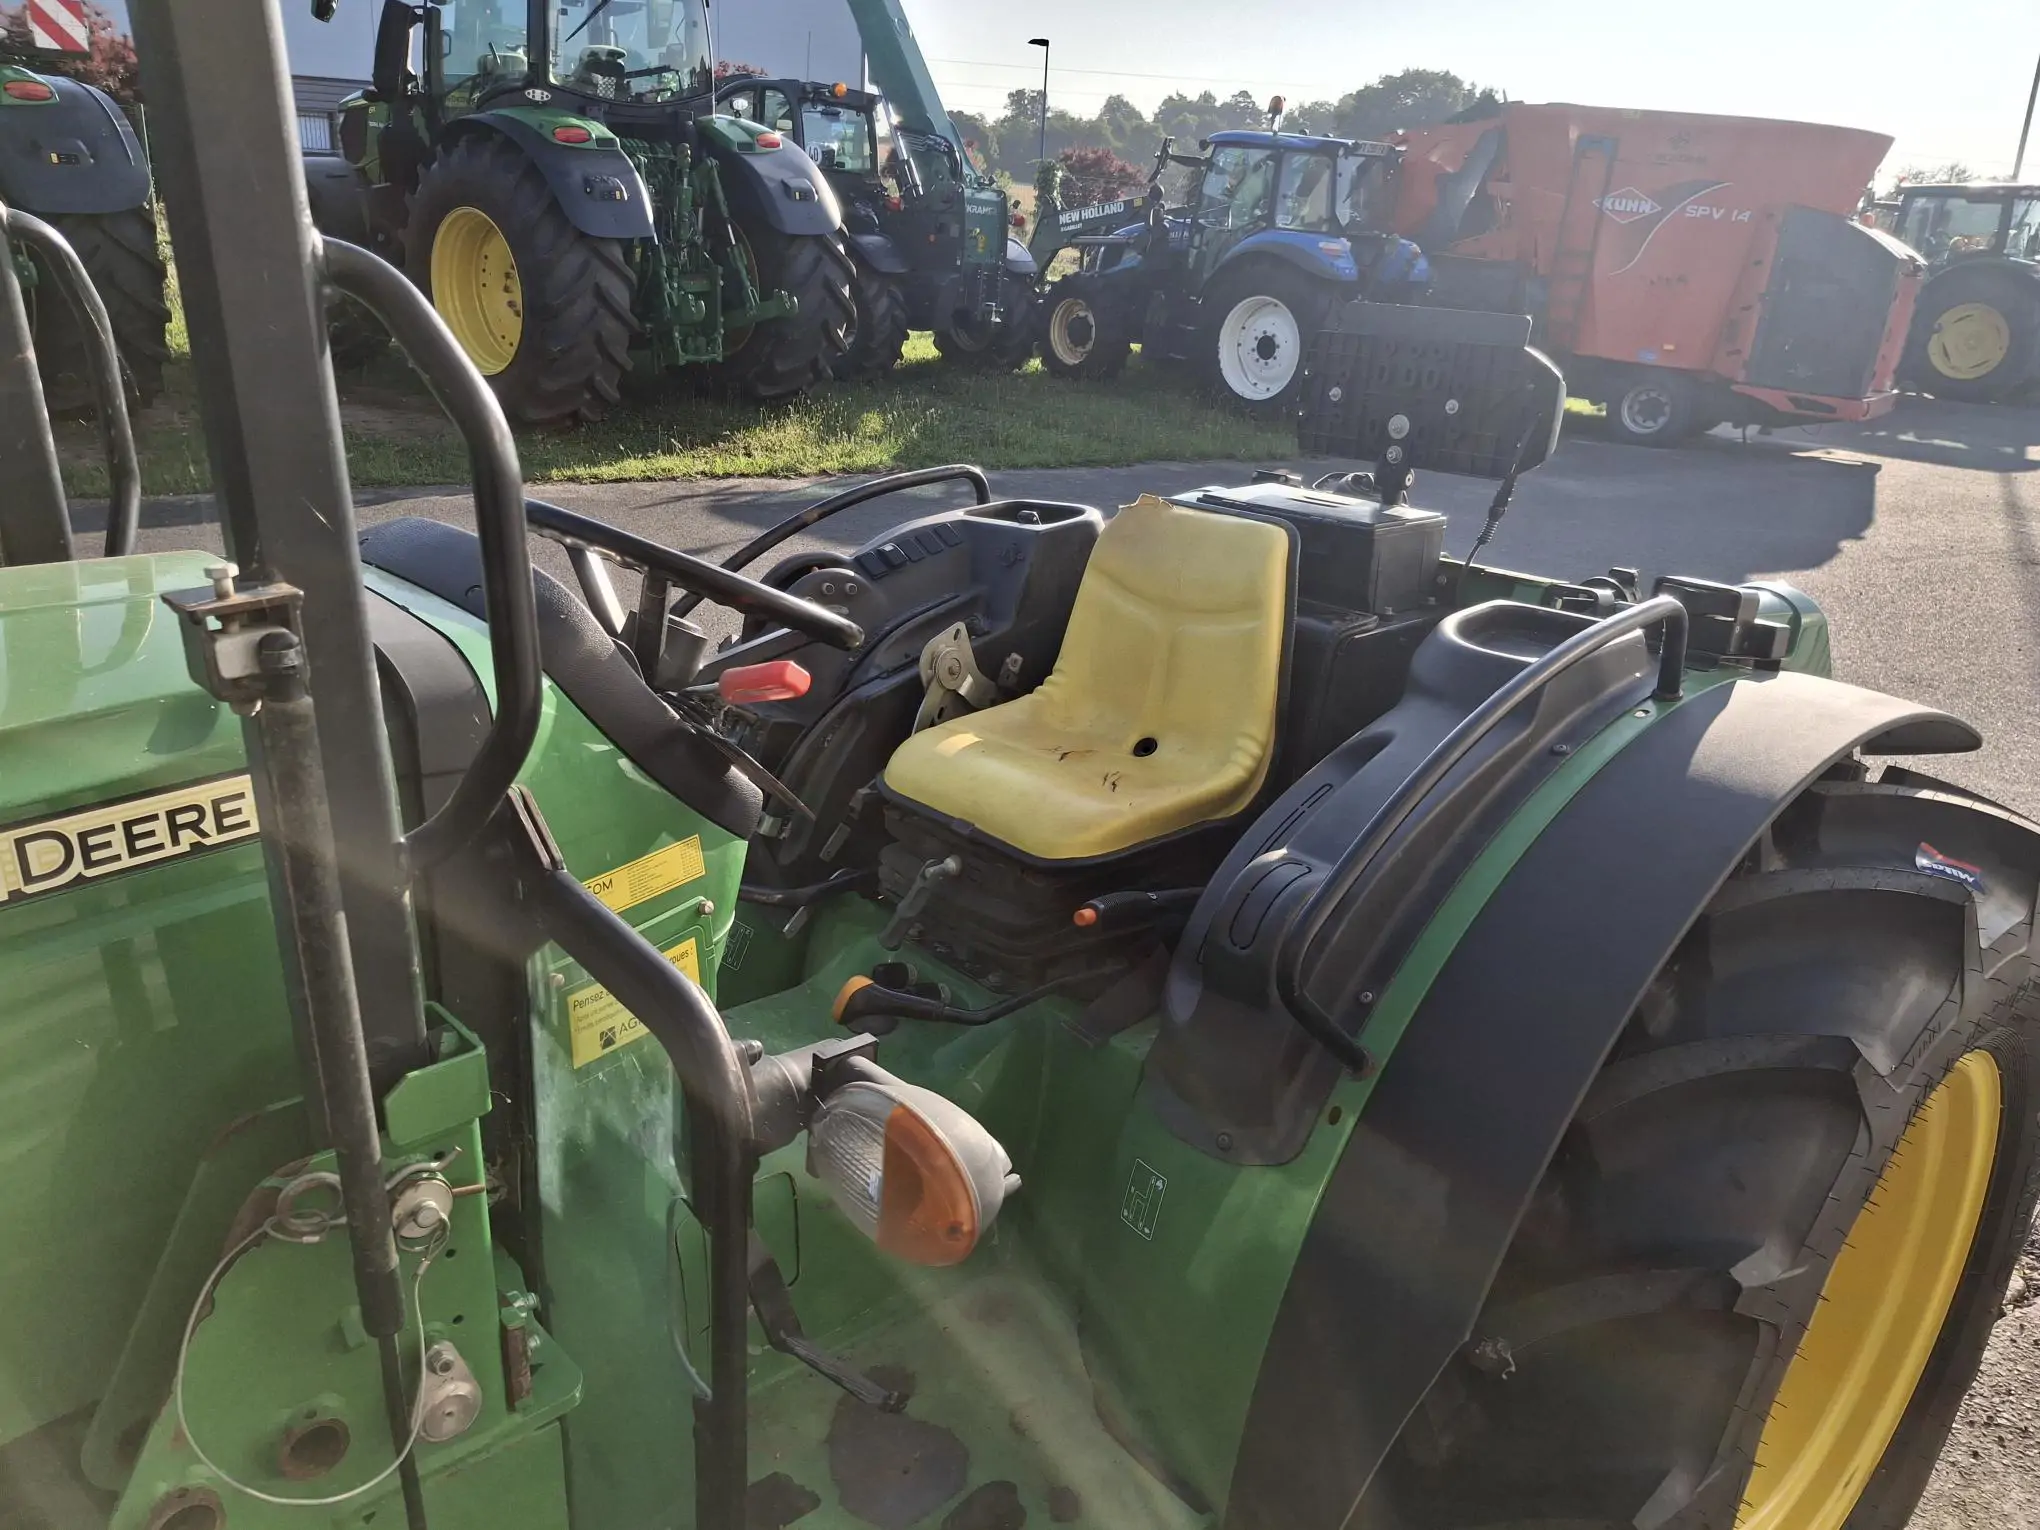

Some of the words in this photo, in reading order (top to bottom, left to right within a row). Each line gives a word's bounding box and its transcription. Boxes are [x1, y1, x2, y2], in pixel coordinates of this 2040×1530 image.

[1059, 210, 1081, 225] NEW
[1081, 201, 1124, 221] HOLLAND
[1685, 204, 1724, 221] SPV
[1731, 208, 1752, 223] 14
[13, 791, 251, 887] DEERE
[573, 989, 604, 1012] Pensez
[619, 1016, 640, 1036] AG
